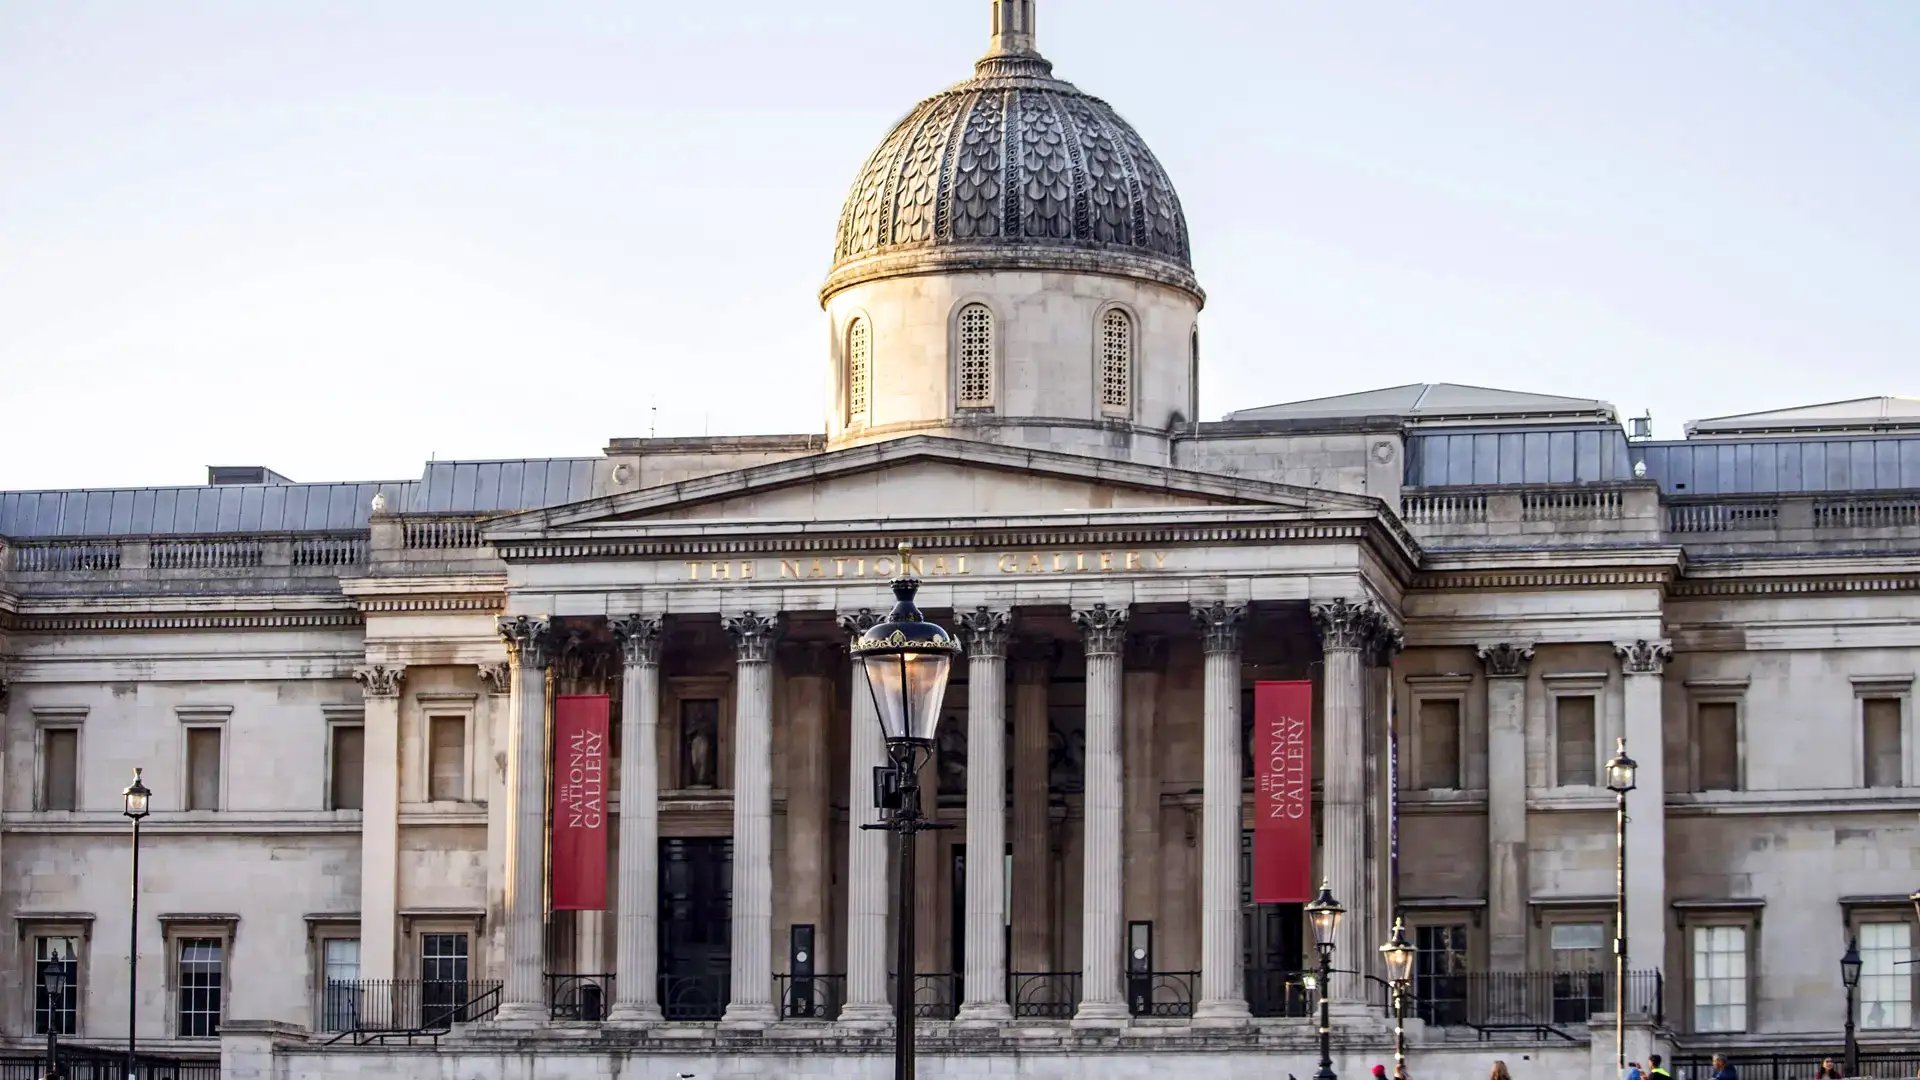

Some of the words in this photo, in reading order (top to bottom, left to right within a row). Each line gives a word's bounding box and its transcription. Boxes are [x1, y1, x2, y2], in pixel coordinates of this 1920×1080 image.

[685, 560, 753, 581] THE
[780, 555, 970, 579] NATIONAL
[998, 551, 1169, 574] GALLERY
[569, 728, 584, 828] NATIONAL
[585, 730, 602, 829] GALLERY
[1270, 716, 1286, 818] NATIONAL
[1286, 716, 1304, 819] GALLERY
